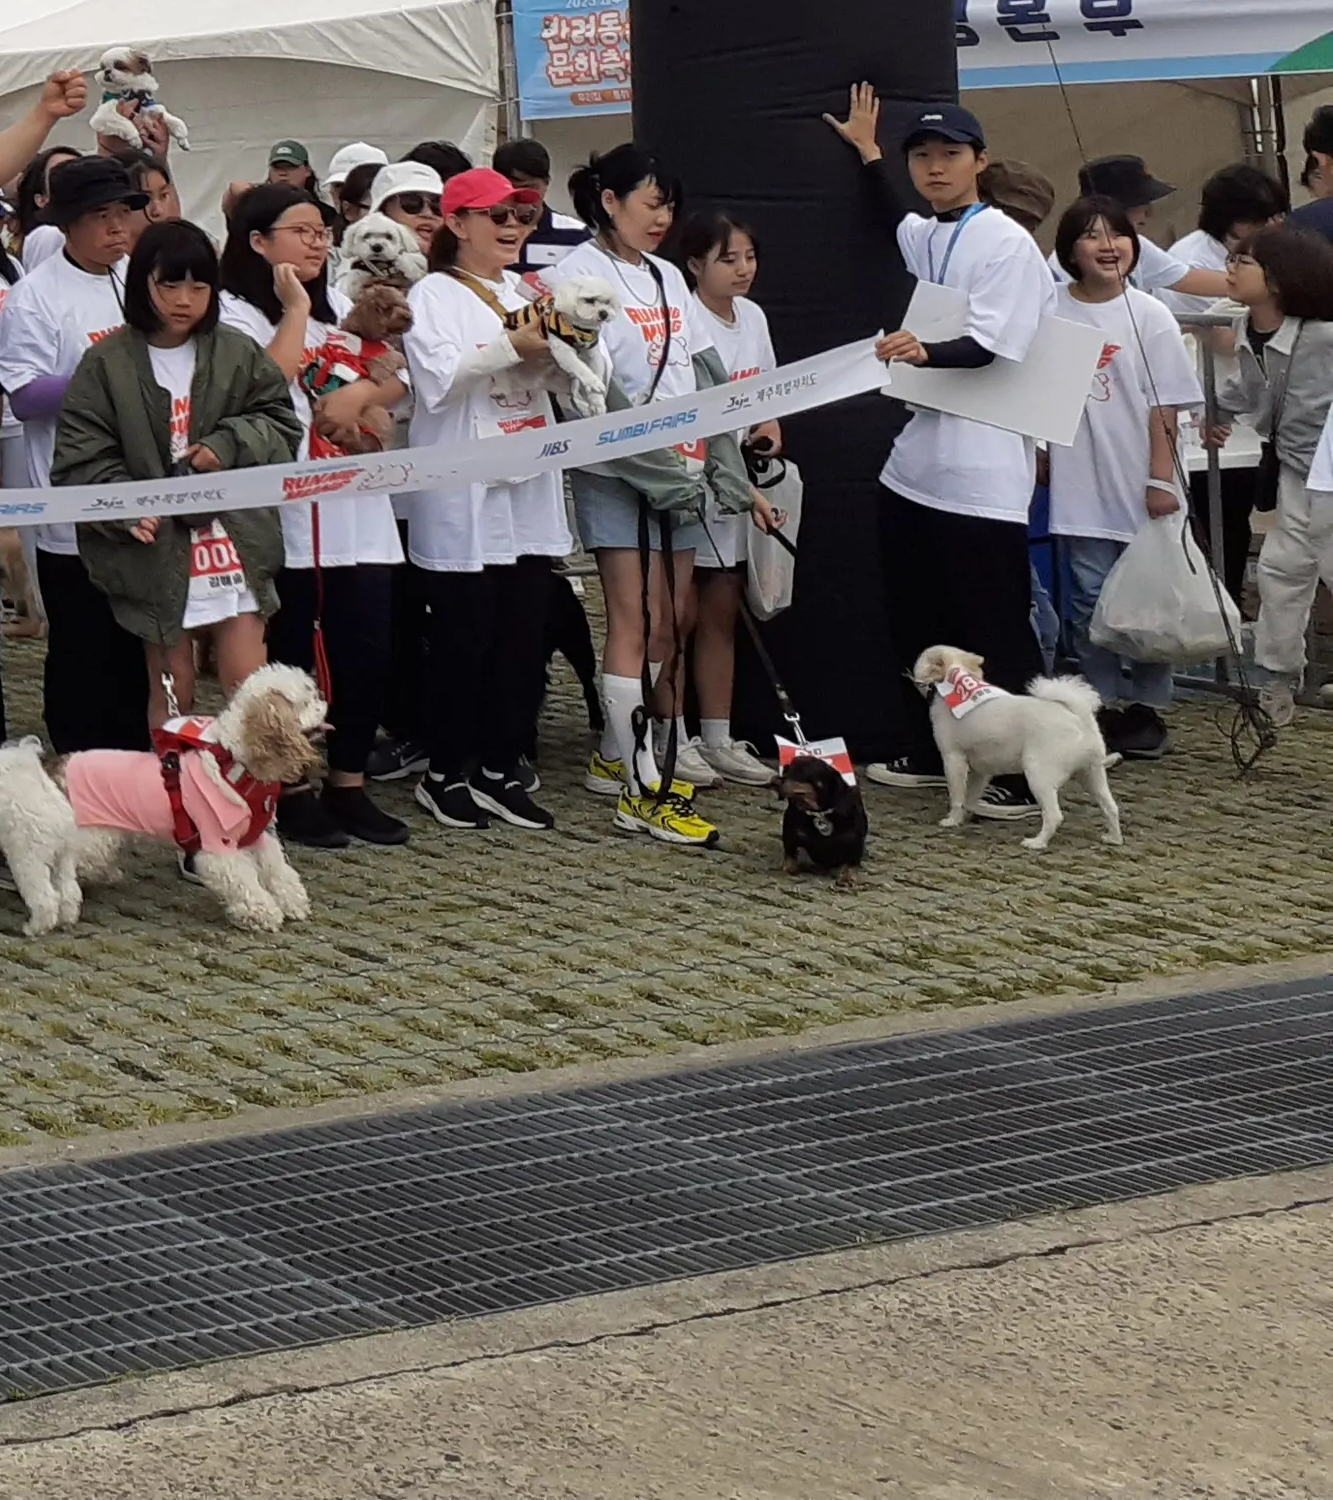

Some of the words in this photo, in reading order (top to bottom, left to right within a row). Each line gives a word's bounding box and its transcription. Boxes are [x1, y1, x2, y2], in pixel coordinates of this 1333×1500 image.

[540, 11, 631, 46] 반려동
[546, 47, 632, 87] 문화축
[535, 439, 573, 460] JIBS
